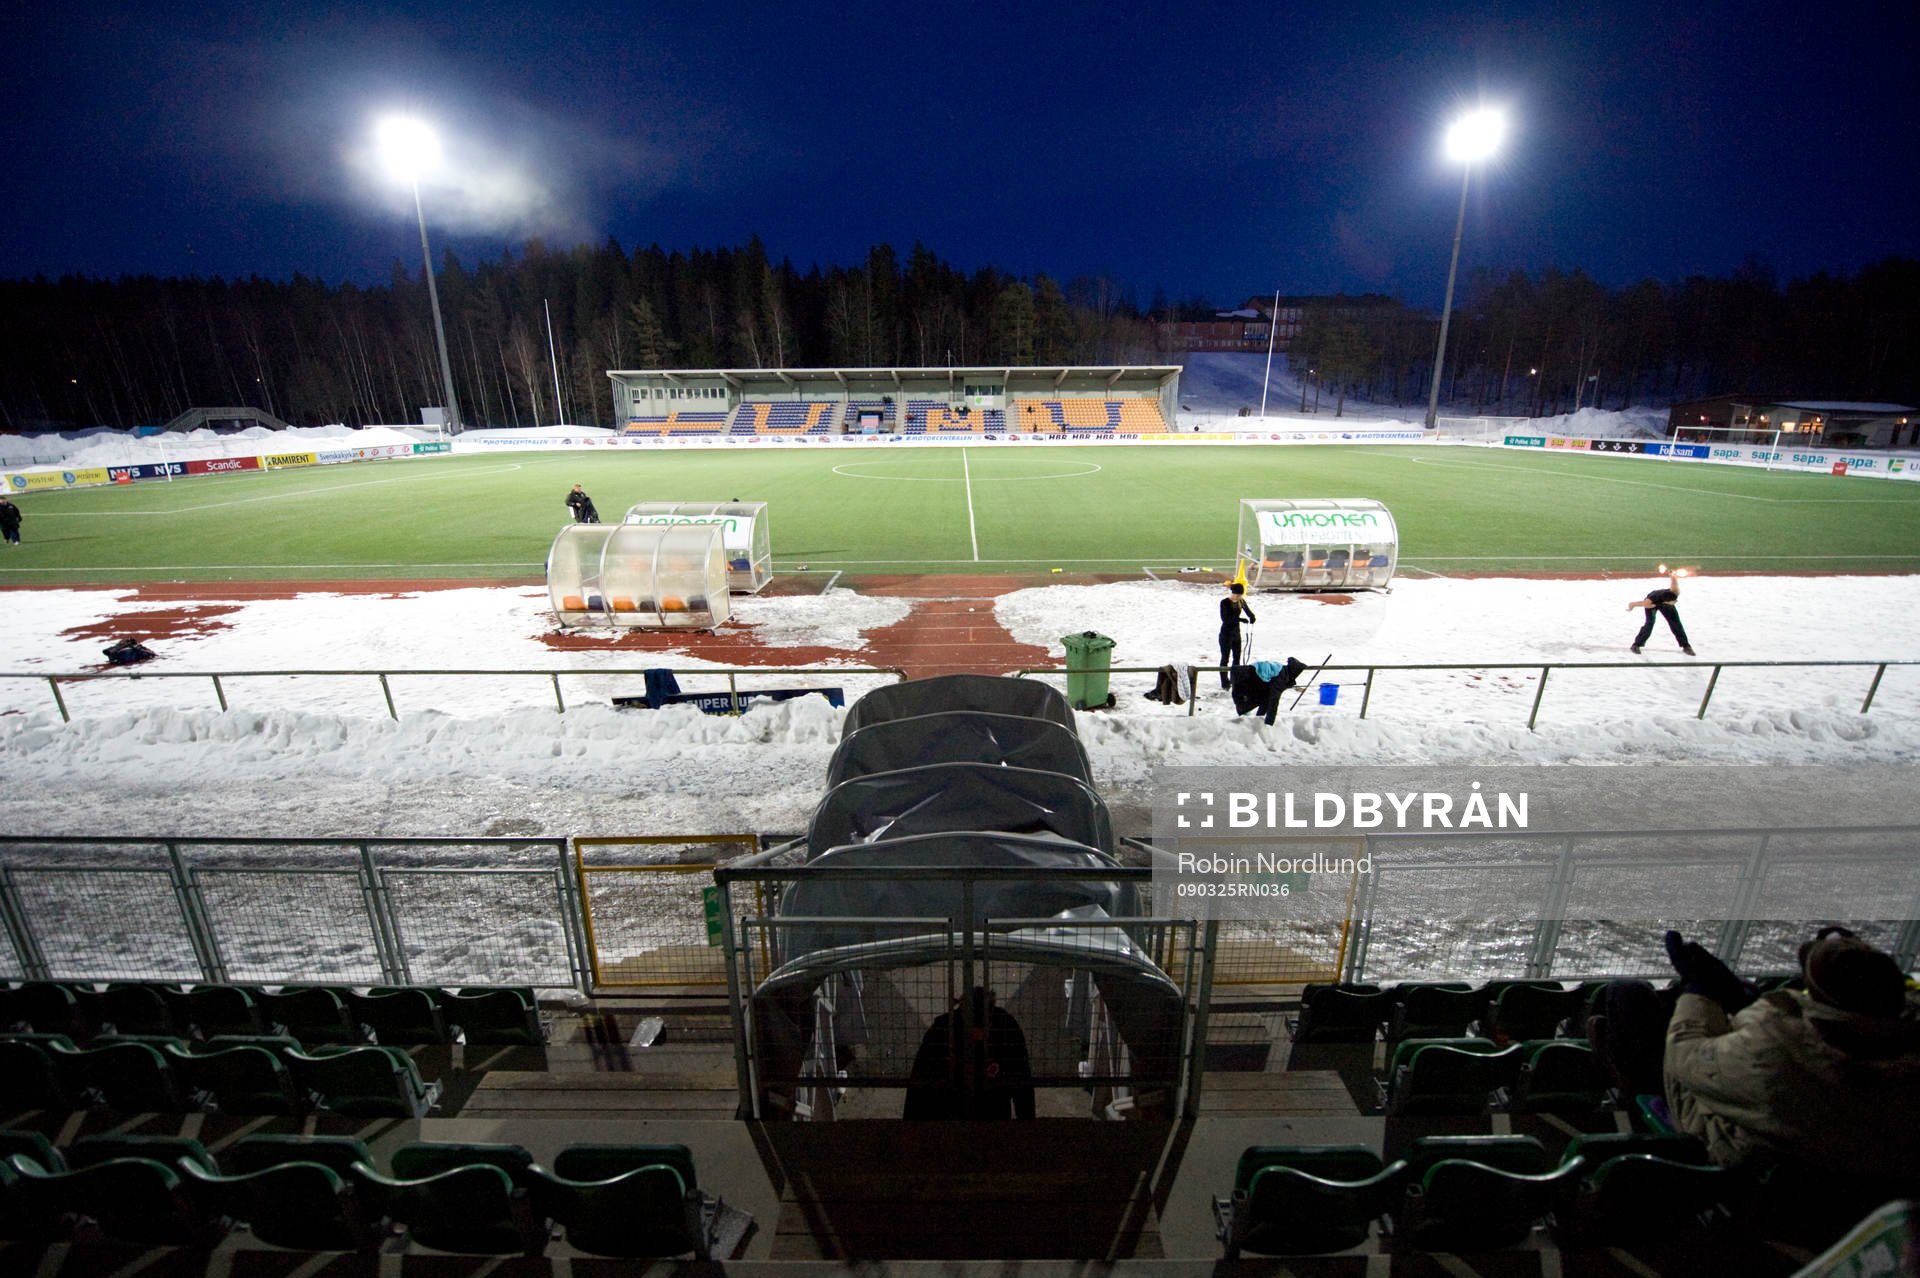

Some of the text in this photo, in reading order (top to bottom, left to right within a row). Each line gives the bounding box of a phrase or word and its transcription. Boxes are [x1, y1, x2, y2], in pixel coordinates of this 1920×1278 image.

[1659, 445, 1694, 456] Foksam
[271, 454, 309, 465] RAMIRENT
[207, 460, 242, 471] Scandic
